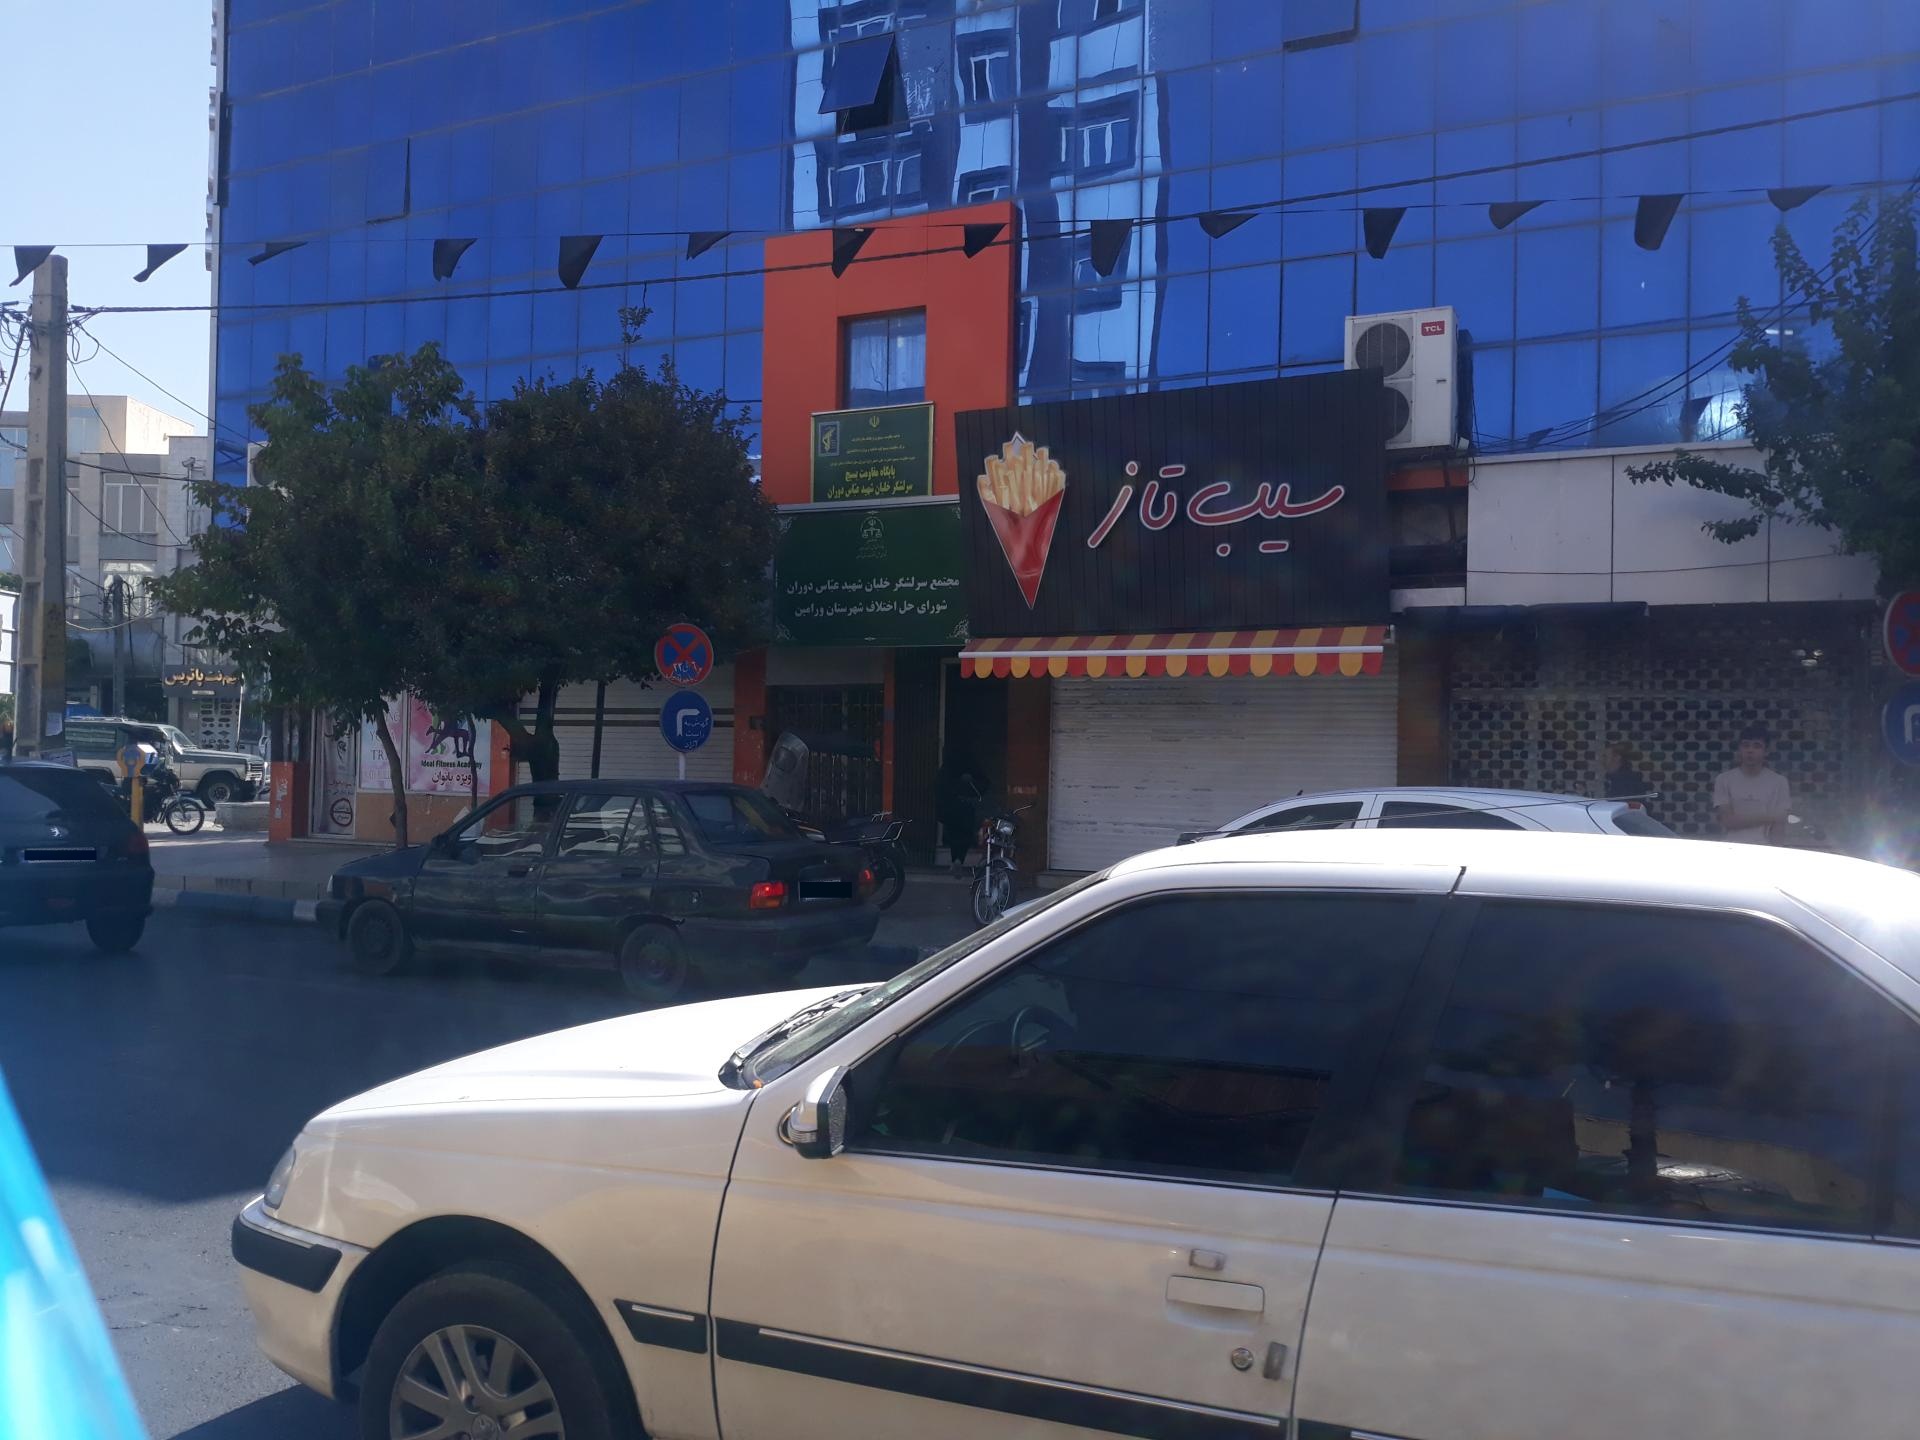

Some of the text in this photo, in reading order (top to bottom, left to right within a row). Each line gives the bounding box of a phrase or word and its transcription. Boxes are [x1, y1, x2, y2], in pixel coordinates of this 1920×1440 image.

[1423, 324, 1442, 333] TCL
[859, 466, 879, 481] مقاومت
[879, 464, 896, 479] پایگاه
[827, 484, 844, 499] دوران
[860, 483, 875, 496] شهید
[874, 481, 891, 495] خلبان
[892, 479, 913, 495] سرلشکر
[1186, 480, 1346, 557] سیب
[787, 579, 814, 595] دوران
[842, 579, 863, 591] شهید
[865, 577, 890, 592] خلبان
[893, 576, 928, 592] سرلشکر
[930, 578, 960, 590] مجتمع
[794, 599, 948, 617] شورای حل اختلاف شهرستان ورامین
[164, 668, 205, 687] پاتریس
[421, 760, 435, 768] Ideal
[436, 760, 456, 768] Fitness
[431, 770, 472, 786] ویژه بانوان
